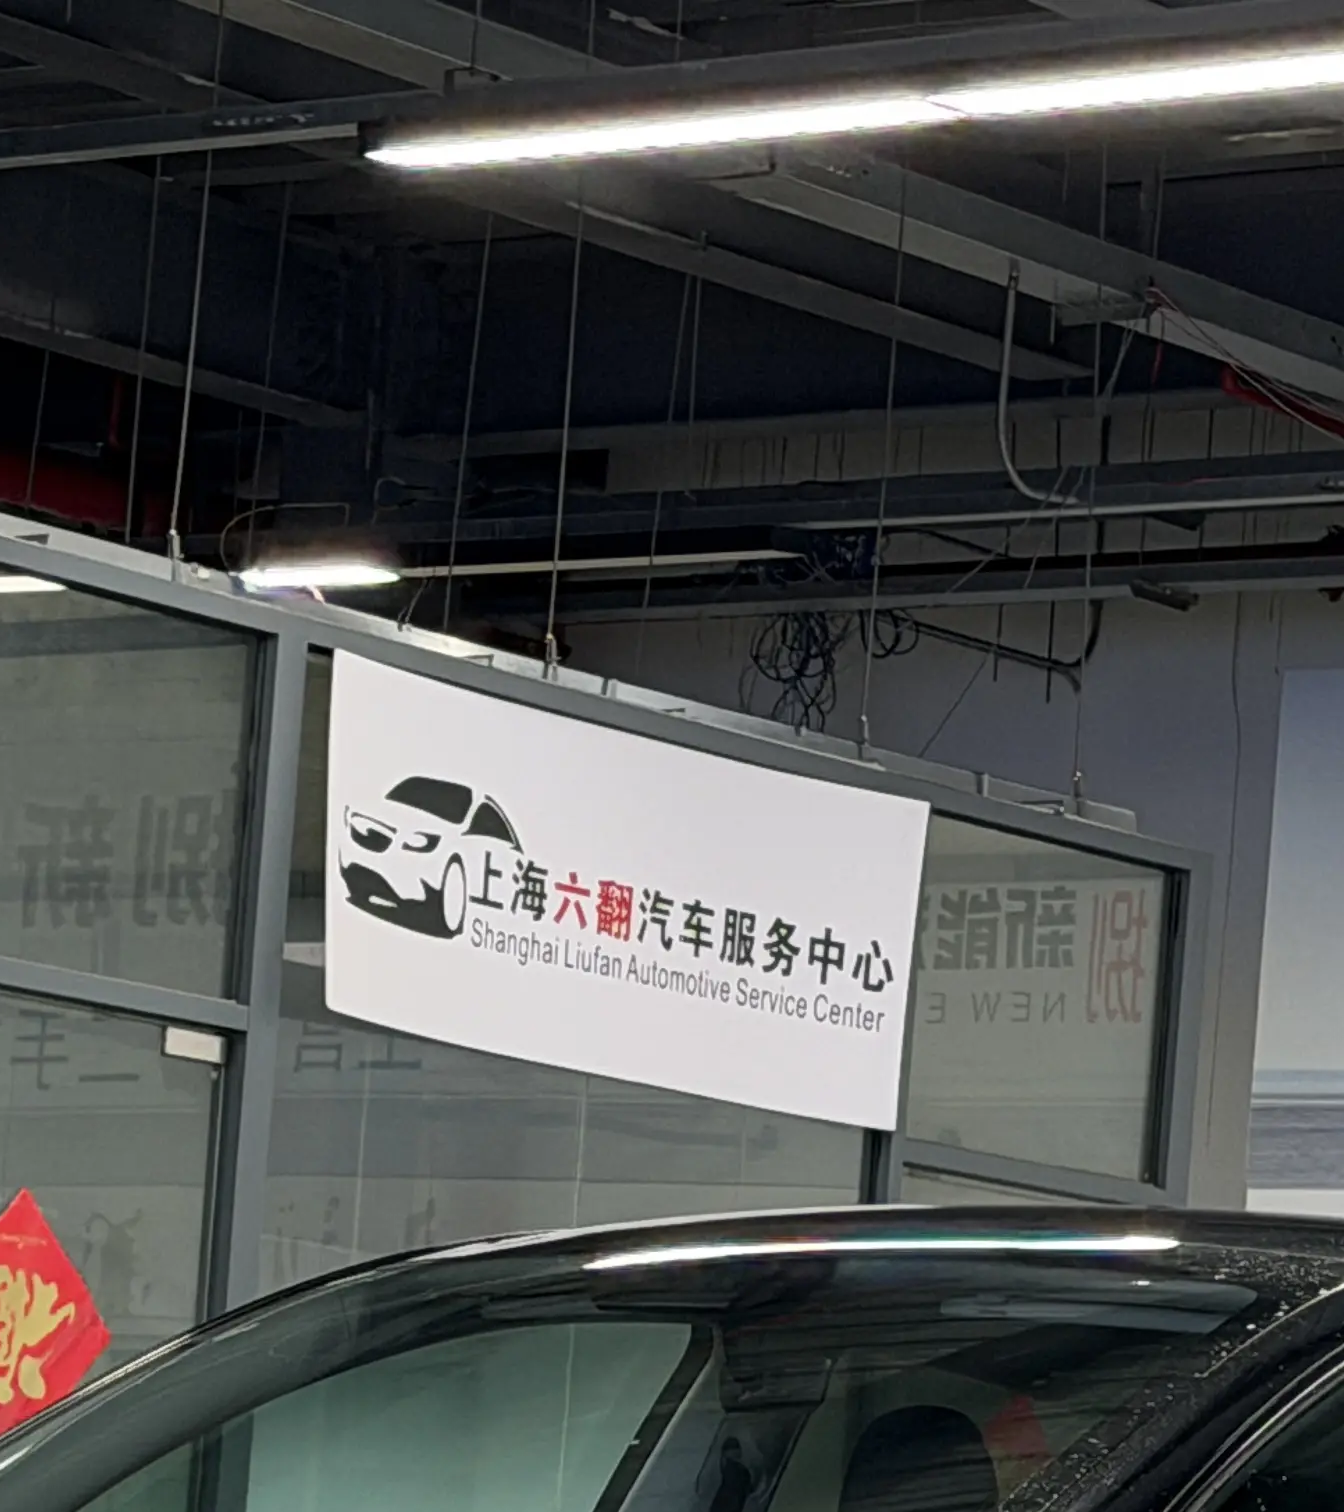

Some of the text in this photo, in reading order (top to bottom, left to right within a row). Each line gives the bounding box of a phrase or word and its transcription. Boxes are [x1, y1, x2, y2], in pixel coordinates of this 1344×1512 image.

[469, 851, 894, 993] 上海六翻汽车服务中心
[470, 917, 561, 967] Shanghai
[563, 939, 623, 981] Liufan
[625, 958, 732, 1004] Automotive
[734, 977, 808, 1022] Service
[812, 994, 886, 1035] Center
